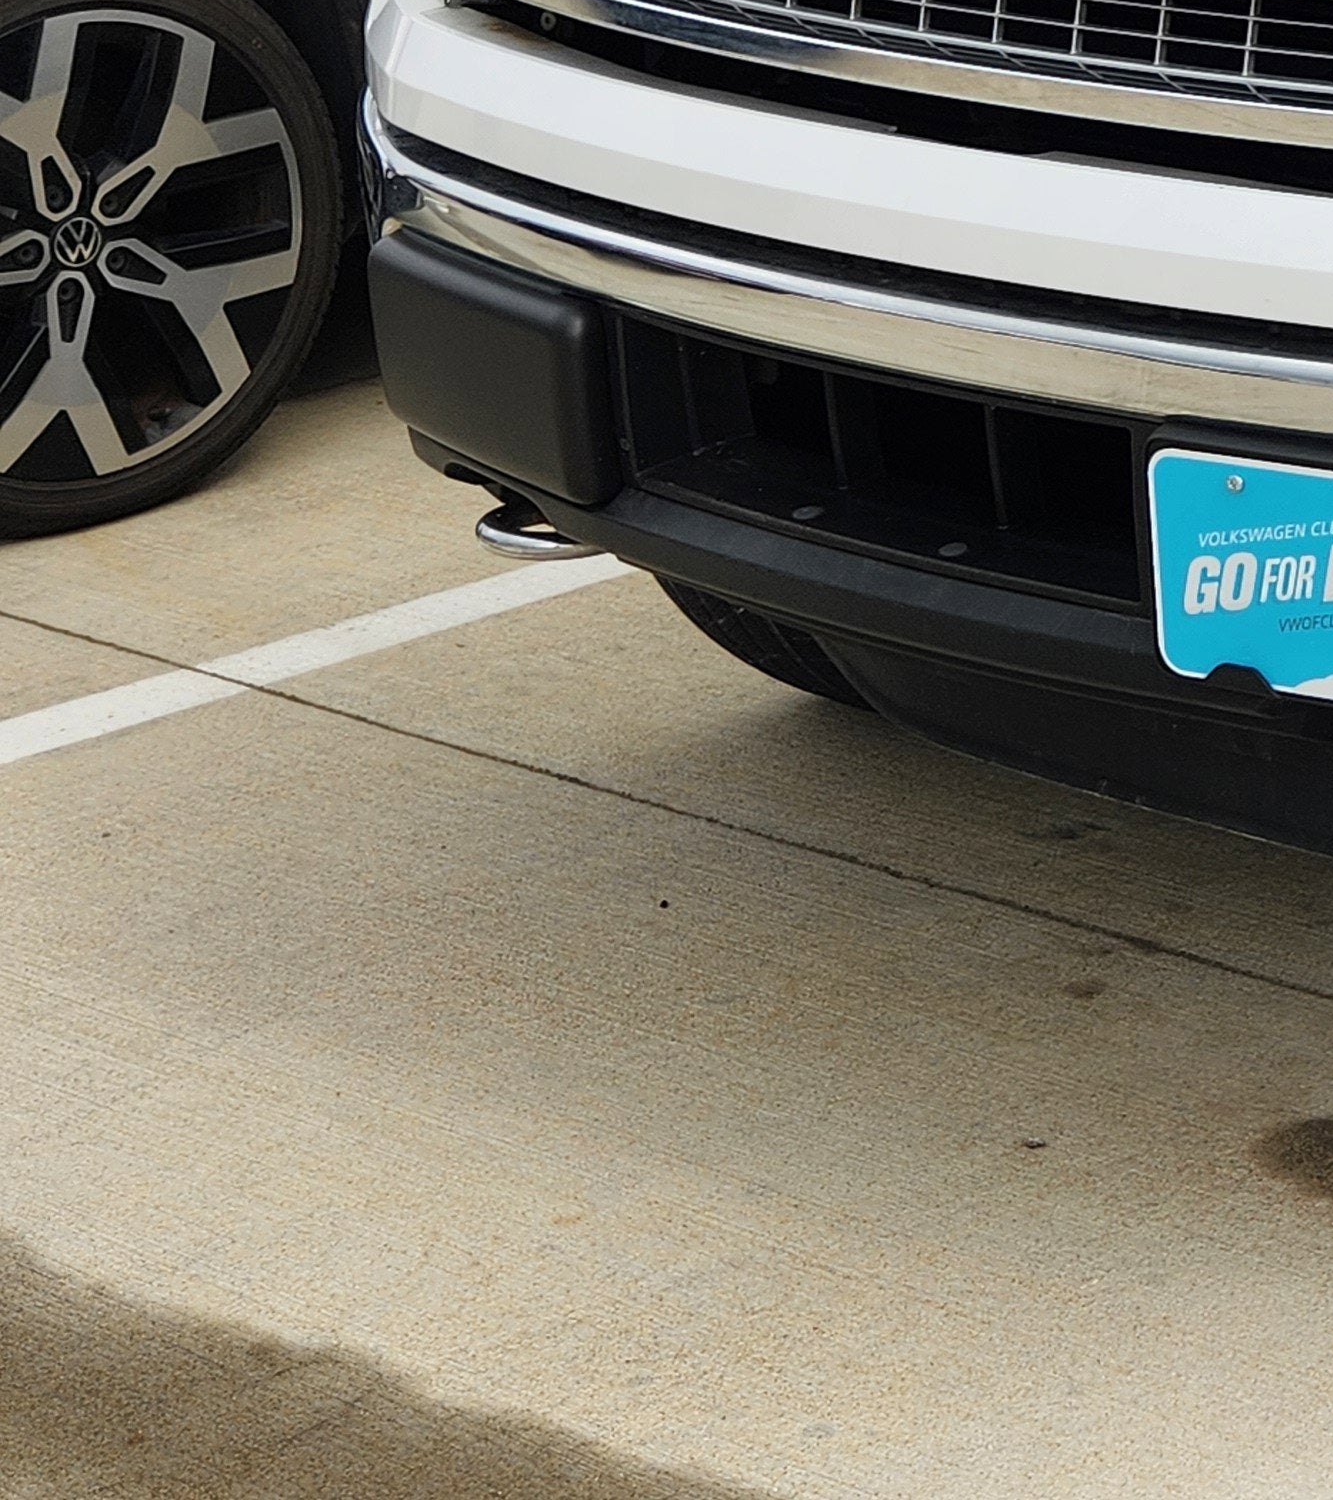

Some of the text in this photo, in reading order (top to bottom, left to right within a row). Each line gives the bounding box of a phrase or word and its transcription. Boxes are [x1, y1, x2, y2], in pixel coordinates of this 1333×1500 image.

[1199, 522, 1306, 548] VOLKSWAGEN
[1183, 551, 1259, 615] GO
[1259, 554, 1317, 603] FOR
